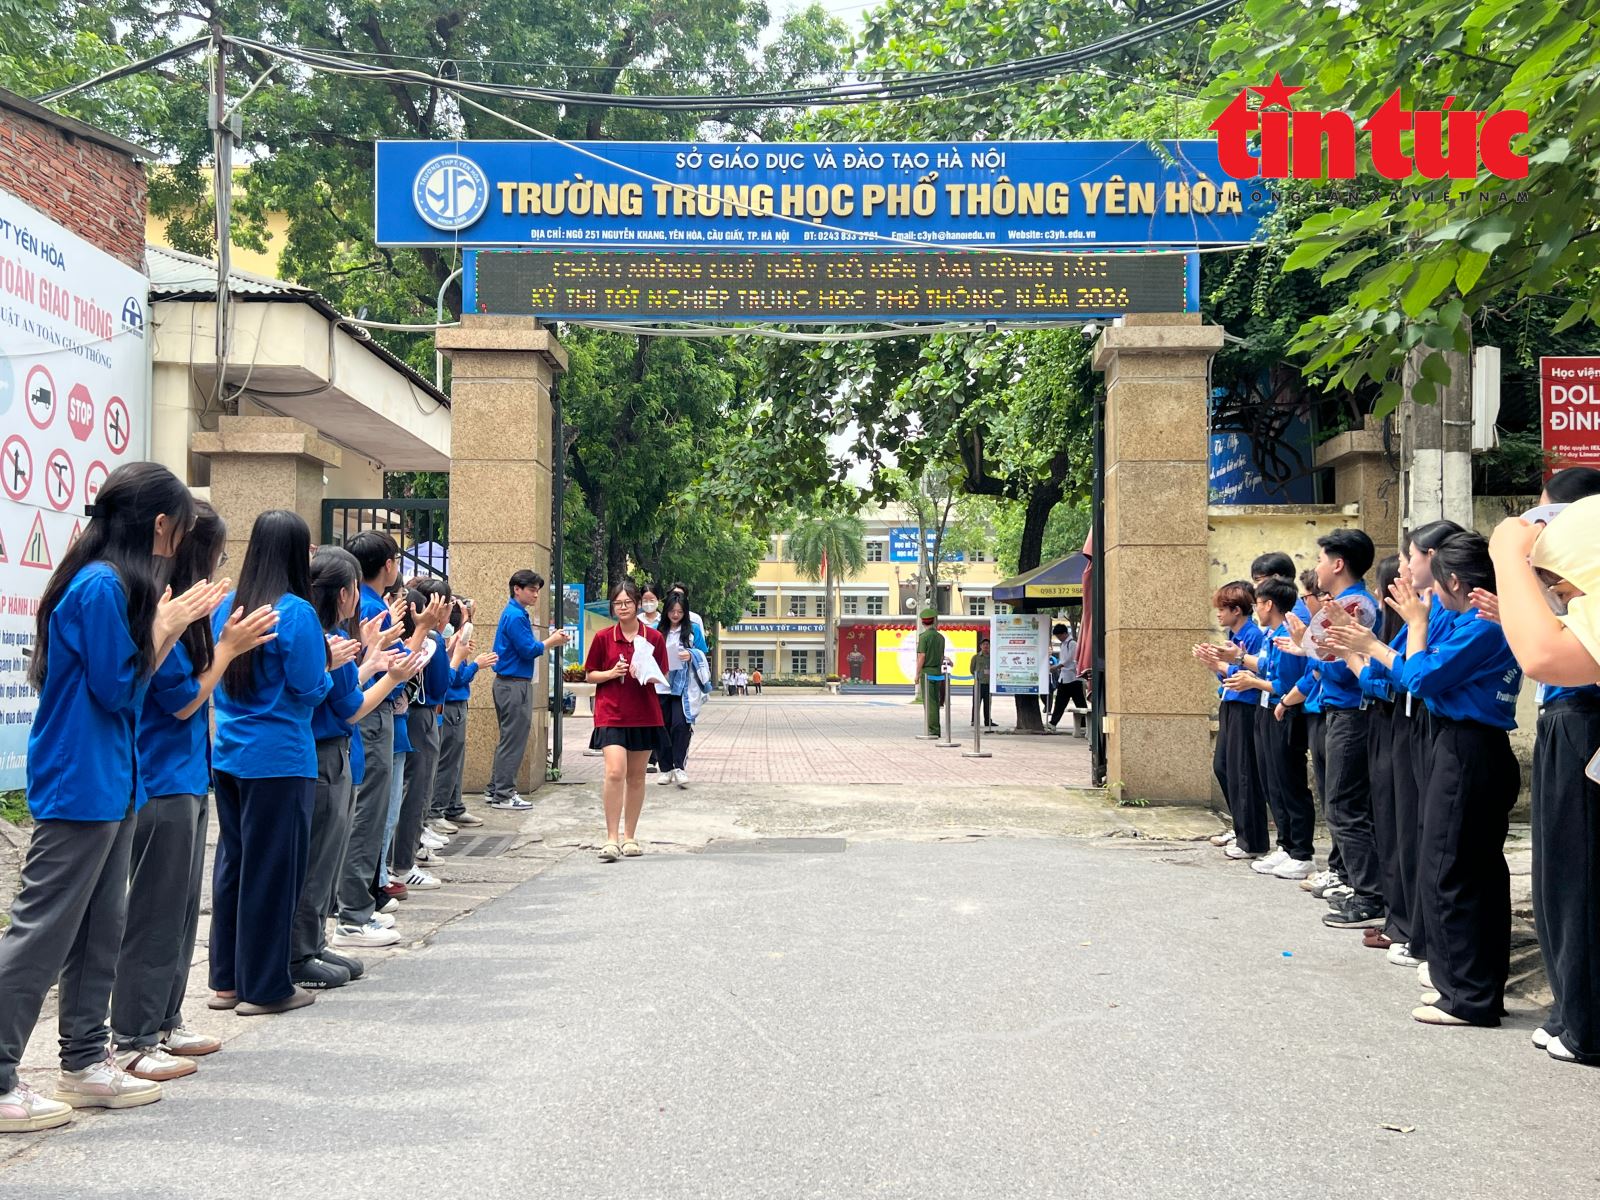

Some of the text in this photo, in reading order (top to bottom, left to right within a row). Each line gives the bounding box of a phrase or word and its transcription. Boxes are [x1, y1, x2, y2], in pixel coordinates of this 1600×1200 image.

[675, 146, 1006, 174] SỞ GIÁO DỤC VÀ ĐÀO TẠO HÀ NỘI
[497, 170, 1243, 224] TRƯỜNG TRUNG HỌC PHỔ THÔNG YÊN HÒA
[531, 229, 545, 240] ĐỊA
[585, 229, 599, 239] 251
[637, 230, 667, 240] KHANG,
[669, 229, 684, 240] YÊN
[686, 229, 705, 241] HÒA,
[748, 231, 760, 240] TP.
[761, 230, 772, 240] HÀ
[775, 229, 789, 243] NỘI
[818, 231, 840, 240] 0243
[891, 231, 916, 240] Email:
[1008, 230, 1043, 240] Website:
[1044, 230, 1096, 240] c3yh.edu.vn
[13, 226, 38, 256] YÊN
[41, 242, 66, 271] HÒA
[39, 277, 70, 321] GIAO
[73, 297, 113, 343] THÔNG
[566, 288, 596, 308] THI
[737, 289, 812, 309] TRUNG
[23, 318, 34, 335] AN
[1551, 367, 1575, 379] Học
[1551, 385, 1600, 405] DOL
[69, 397, 92, 426] STOP
